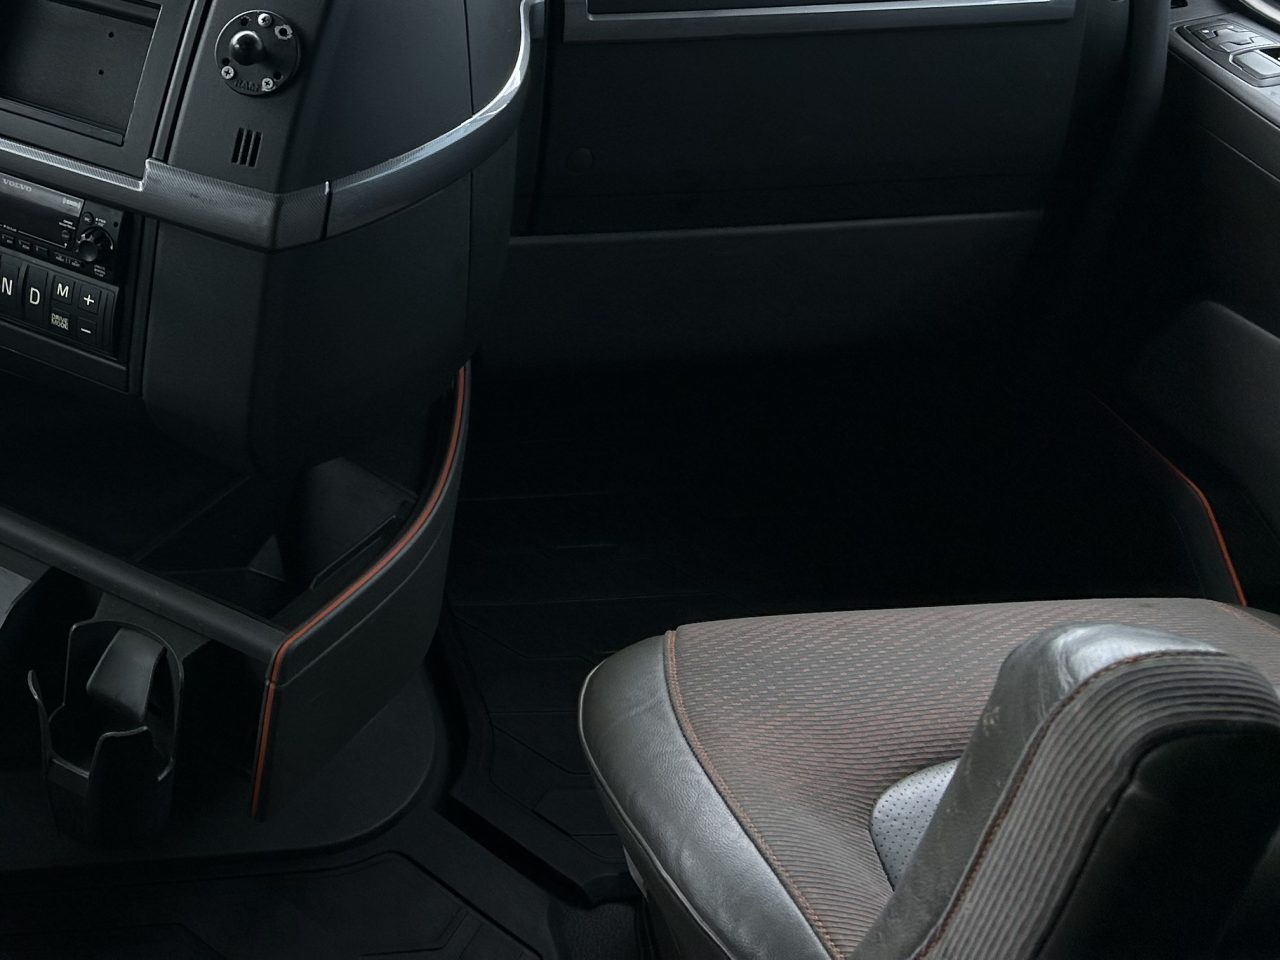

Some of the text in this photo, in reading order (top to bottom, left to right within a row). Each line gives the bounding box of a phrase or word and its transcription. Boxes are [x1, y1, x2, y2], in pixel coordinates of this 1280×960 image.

[2, 178, 32, 192] VOLVO
[1, 277, 13, 296] N
[29, 287, 40, 305] D
[56, 283, 69, 298] M
[51, 312, 68, 323] DRIVE
